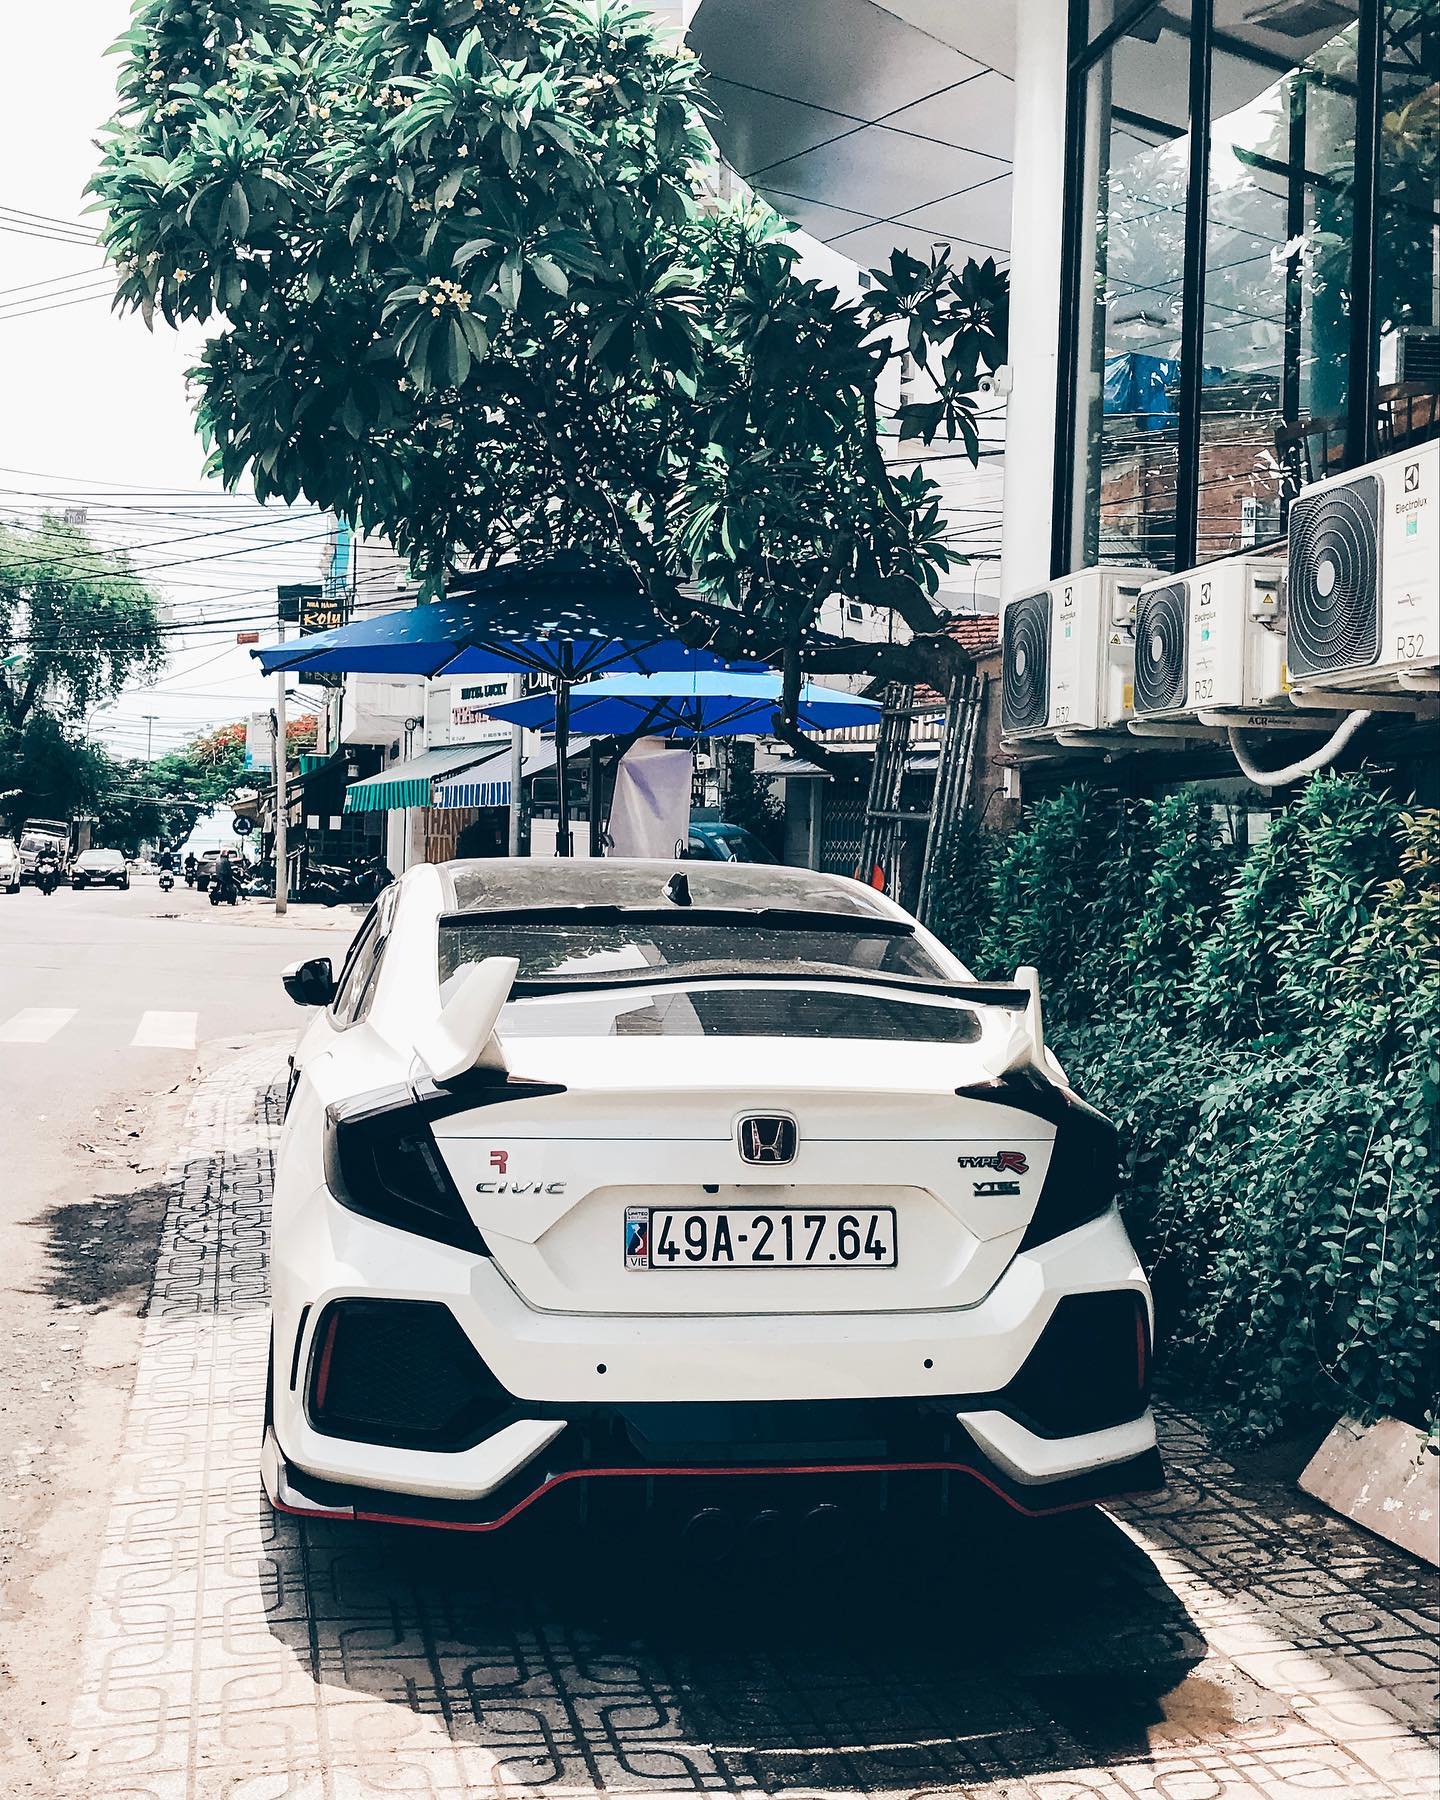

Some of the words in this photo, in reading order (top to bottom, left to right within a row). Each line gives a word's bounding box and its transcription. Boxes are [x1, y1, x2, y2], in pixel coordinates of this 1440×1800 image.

[1395, 497, 1428, 514] Electrolux
[1397, 634, 1425, 660] R32
[1194, 678, 1214, 701] R32
[1055, 706, 1070, 725] R32
[1247, 716, 1269, 726] ACR
[957, 1156, 999, 1169] TYPE
[994, 1151, 1029, 1175] R
[475, 1182, 567, 1194] CIVIC
[972, 1181, 1020, 1194] VTEC
[657, 1214, 888, 1262] 49A-217.64
[630, 1257, 648, 1267] VIE
